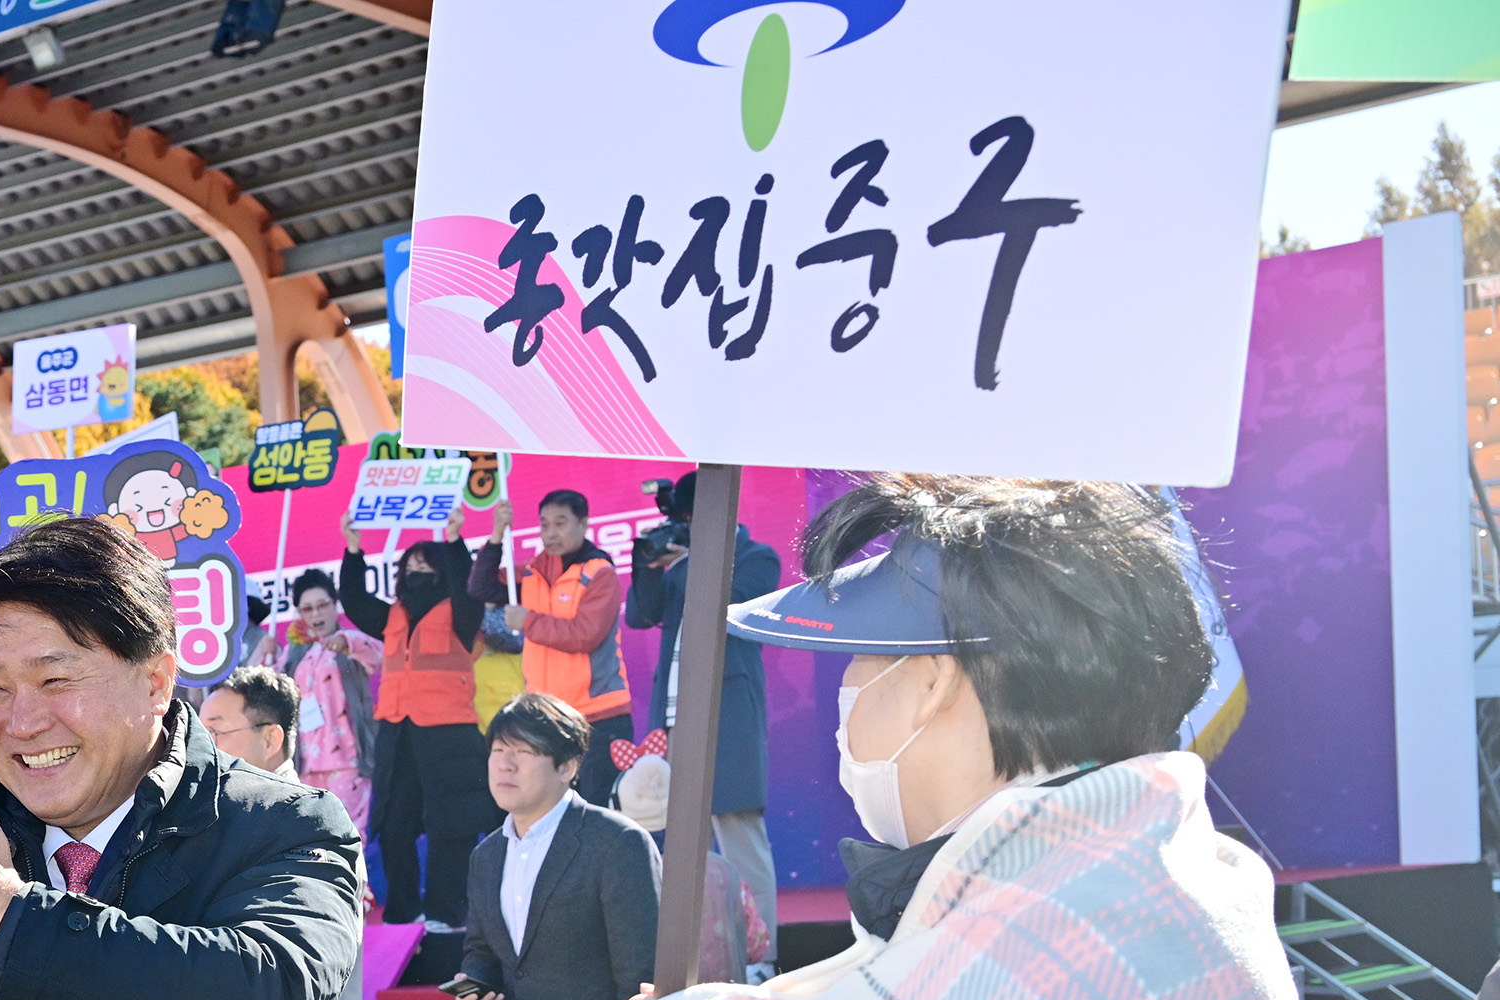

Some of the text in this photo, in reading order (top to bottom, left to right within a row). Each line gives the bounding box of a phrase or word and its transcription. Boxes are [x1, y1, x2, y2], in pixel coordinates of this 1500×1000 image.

[25, 376, 88, 409] 삼동면
[253, 438, 332, 486] 성안동
[363, 464, 464, 487] 맛집의 보고
[354, 494, 455, 521] 남목2동
